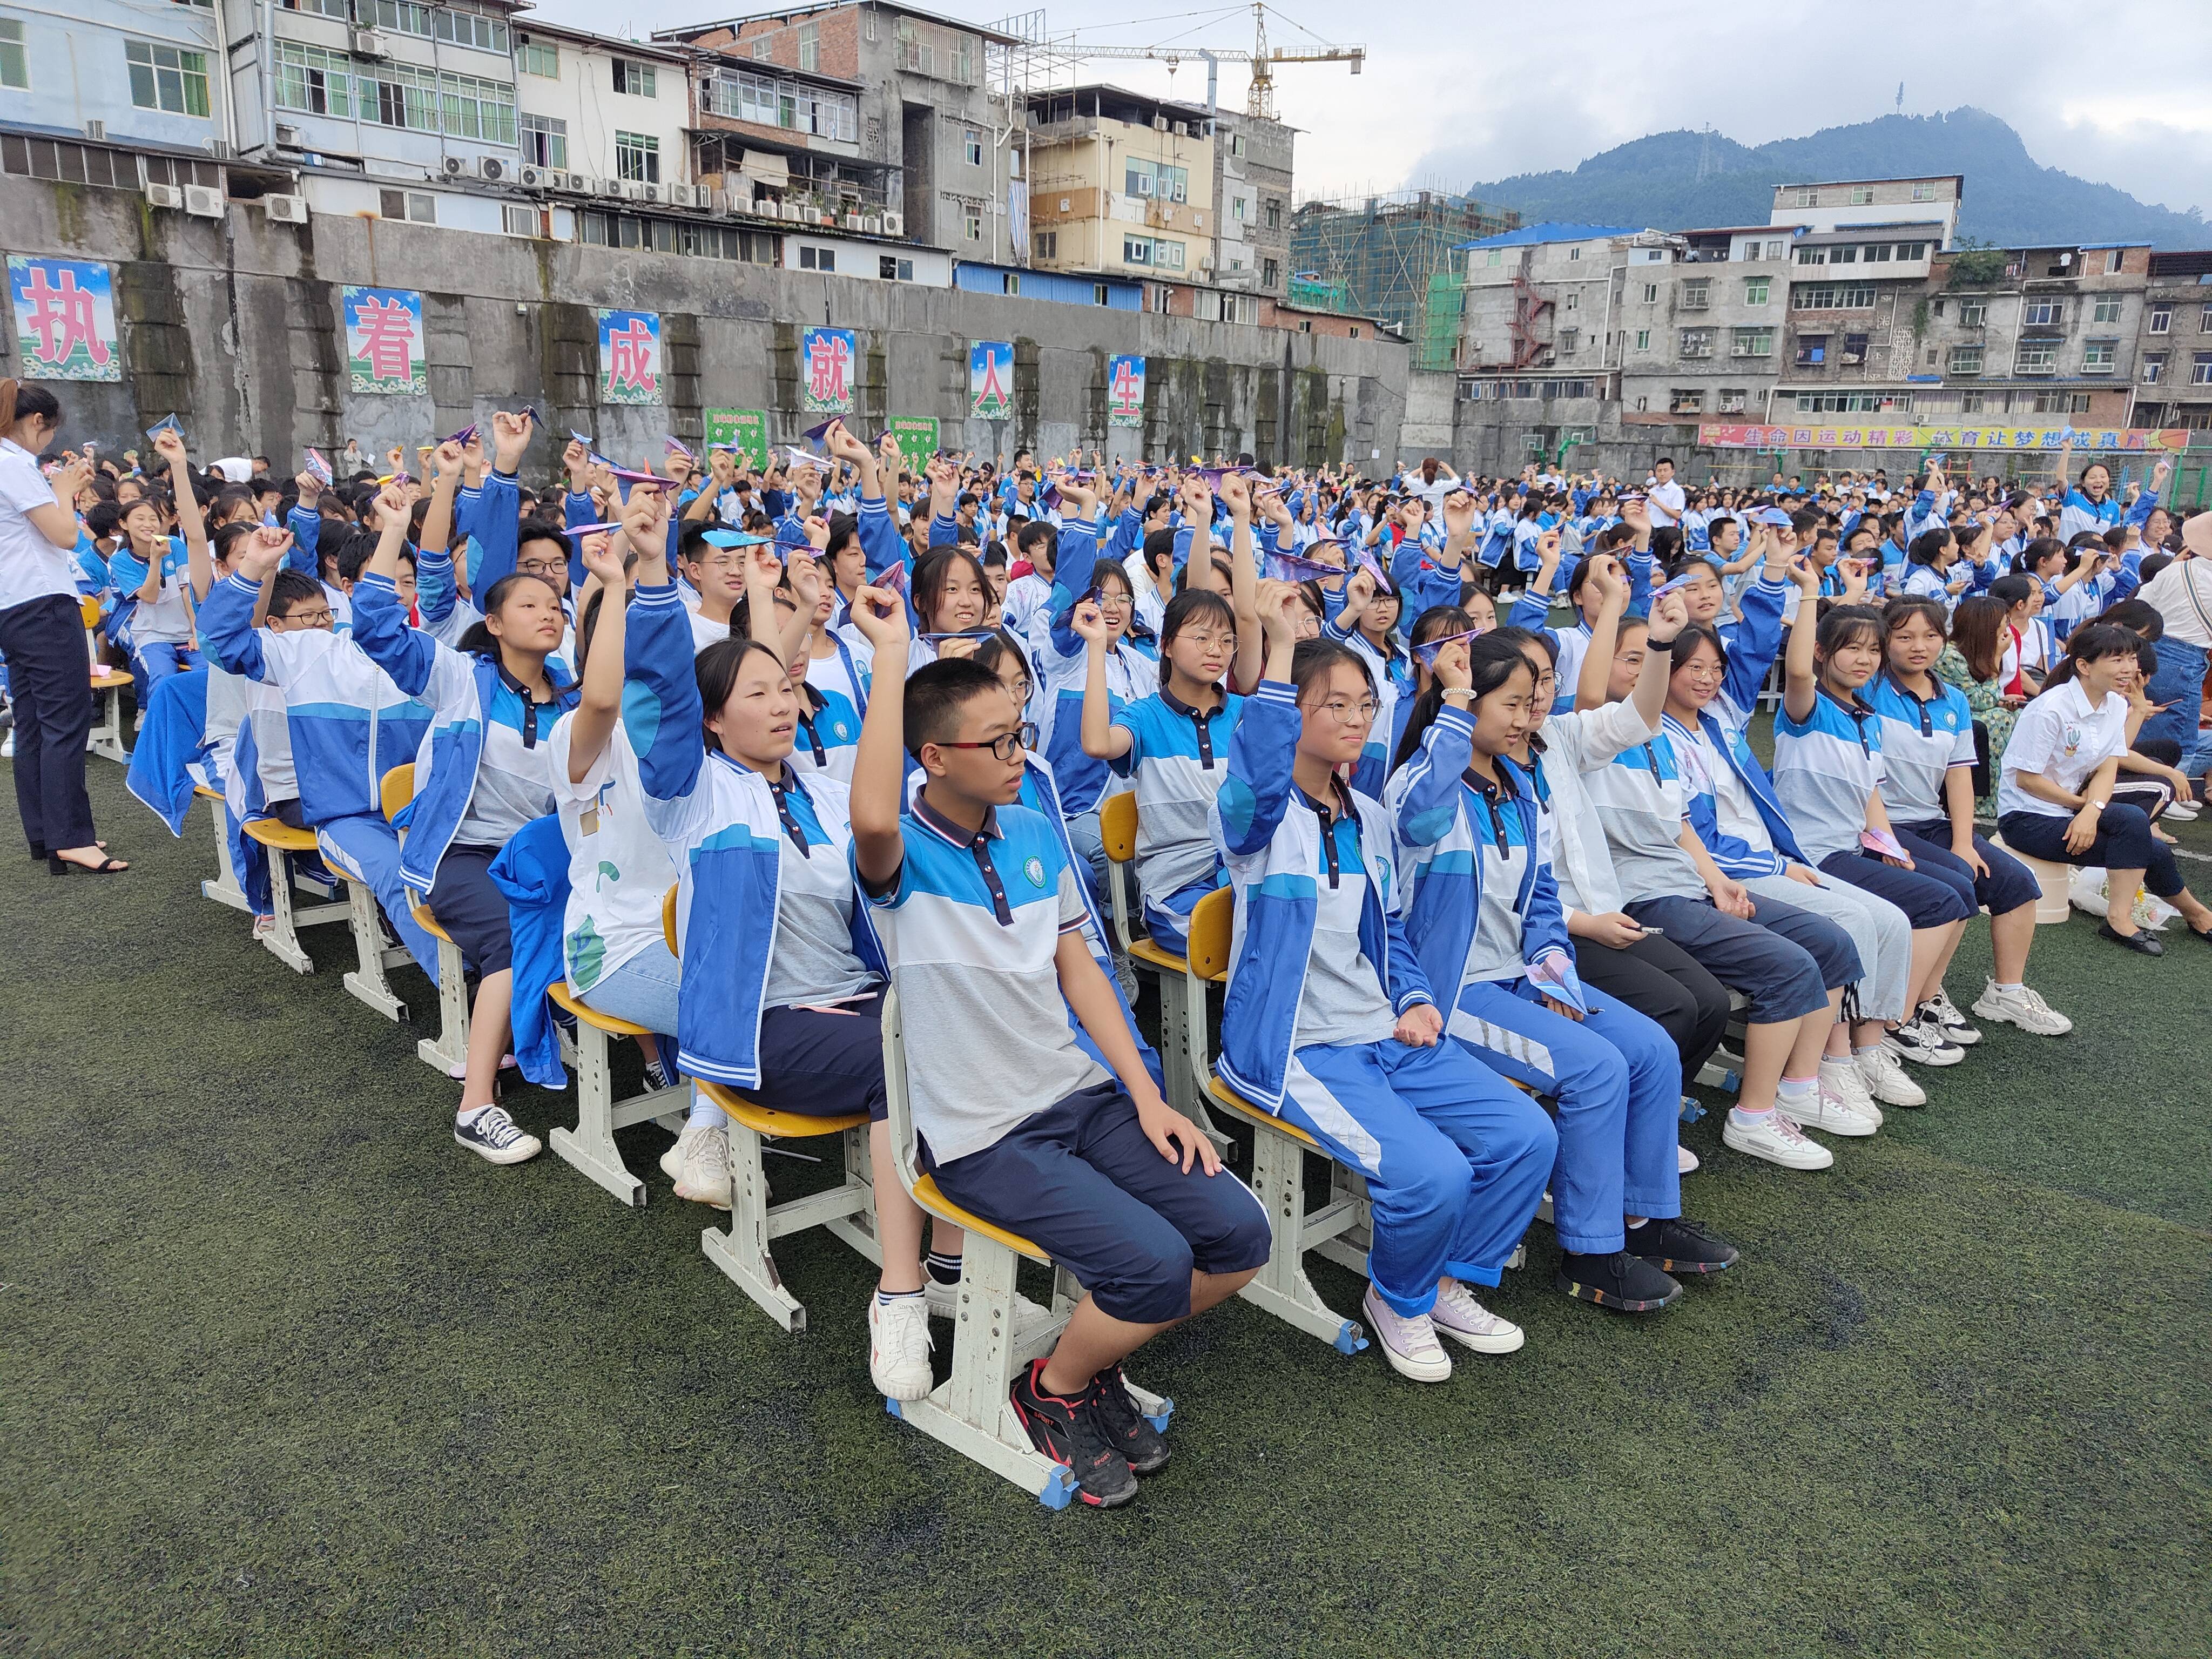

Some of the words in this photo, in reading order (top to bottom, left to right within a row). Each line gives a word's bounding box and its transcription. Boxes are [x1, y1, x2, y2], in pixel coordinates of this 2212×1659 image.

[20, 266, 111, 366] 执
[354, 295, 415, 382] 着
[606, 318, 657, 393] 成
[808, 334, 851, 402] 就
[974, 350, 1008, 408] 人
[1112, 361, 1141, 416] 生
[1744, 427, 1914, 446] 生命因运动精彩
[1932, 430, 2121, 448] 体育让梦想成真
[1034, 1412, 1054, 1426] SPORT
[1094, 1452, 1111, 1466] SPORT
